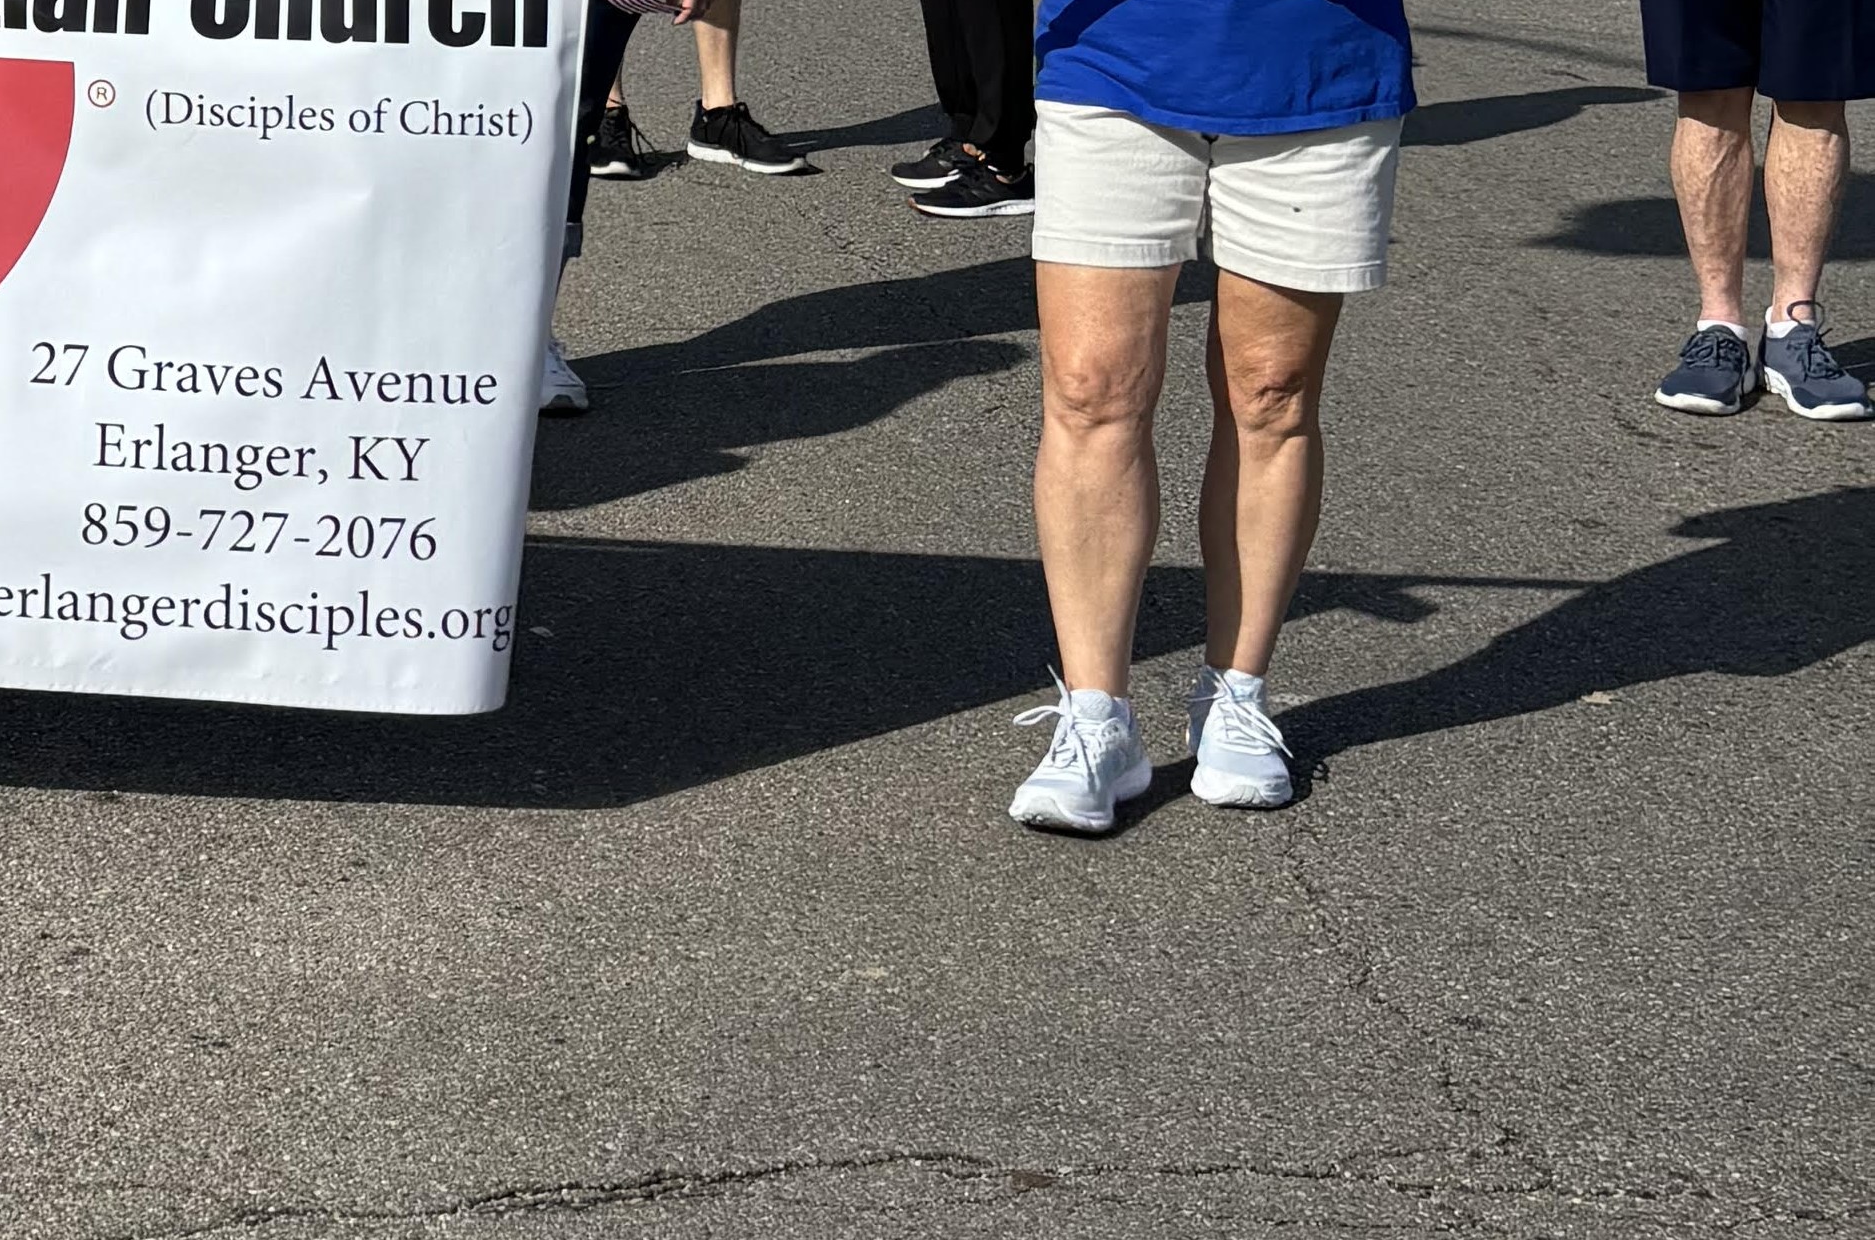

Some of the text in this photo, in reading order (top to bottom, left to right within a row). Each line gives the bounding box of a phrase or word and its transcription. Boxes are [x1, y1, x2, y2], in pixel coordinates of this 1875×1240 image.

[145, 89, 534, 145] (Disciples of Christ)
[29, 341, 499, 405] 27 Graves Avenue
[93, 421, 431, 491] Erlanger, KY
[81, 502, 438, 561] 859-727-2076
